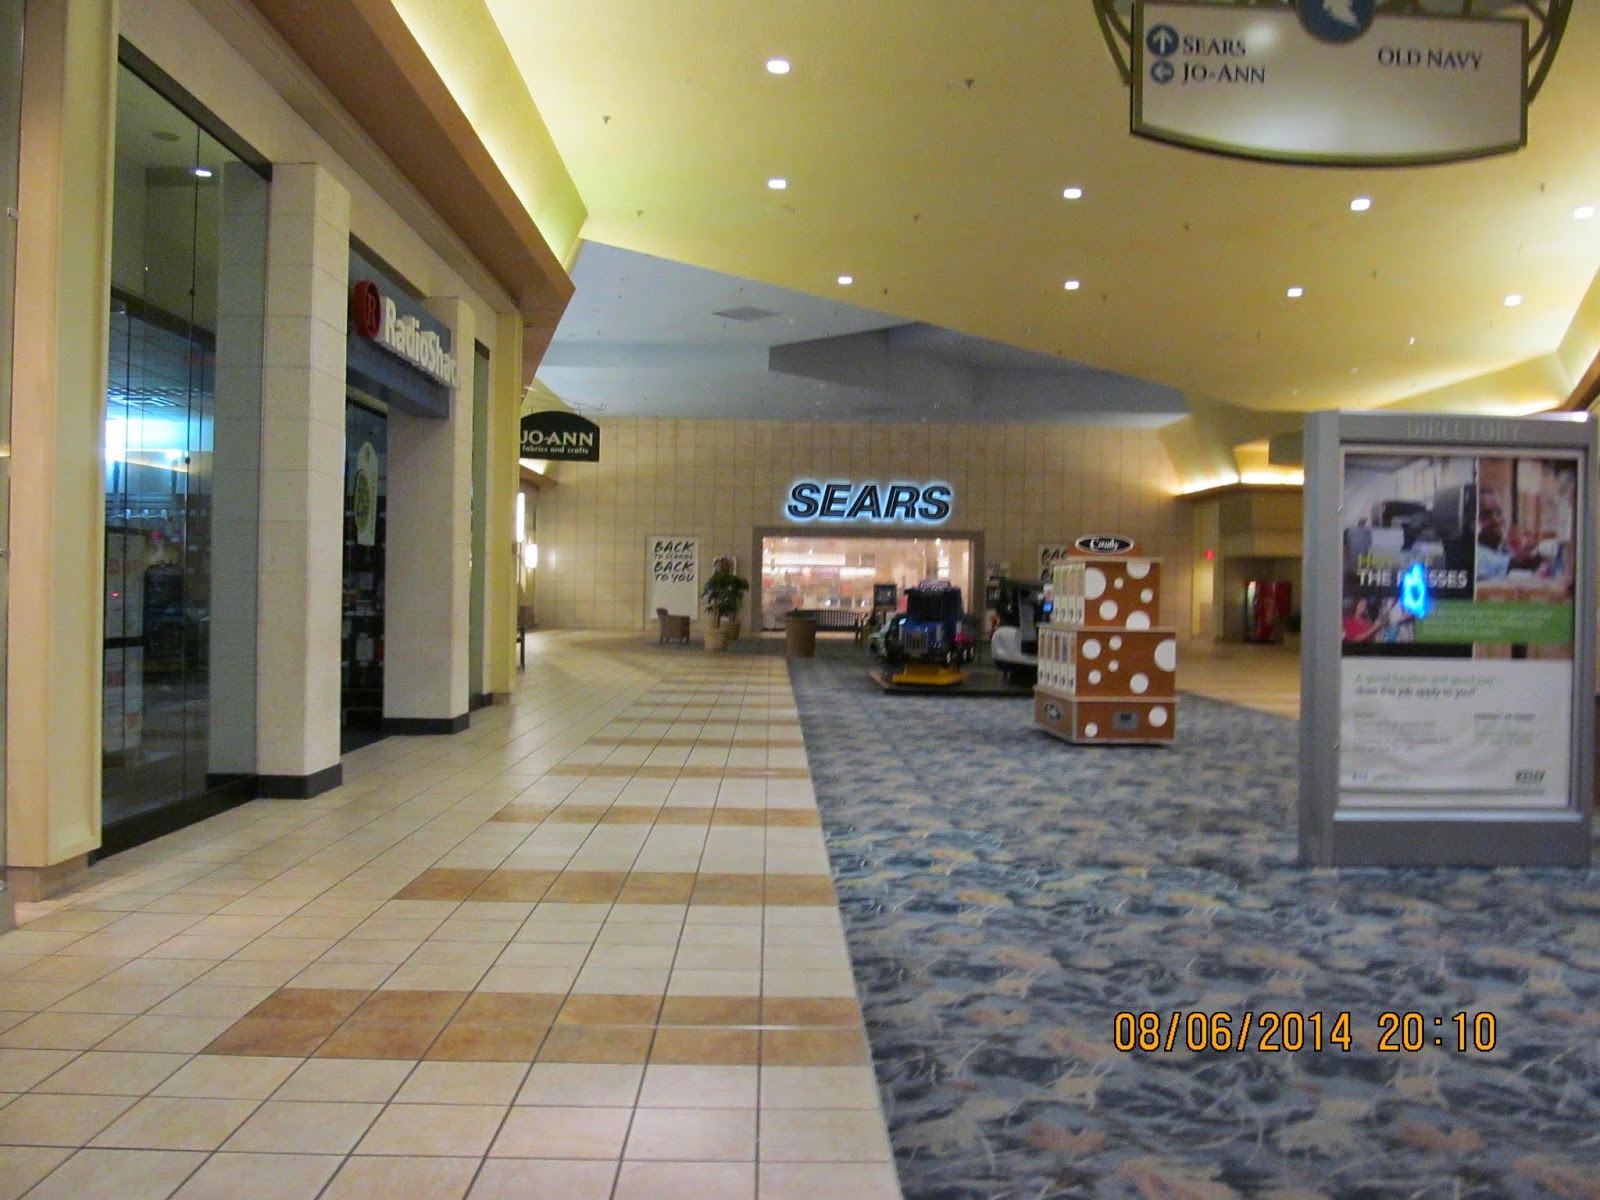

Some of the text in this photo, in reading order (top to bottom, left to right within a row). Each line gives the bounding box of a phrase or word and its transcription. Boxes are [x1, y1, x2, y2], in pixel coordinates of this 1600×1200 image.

[1182, 34, 1246, 57] SEARS
[1377, 45, 1482, 71] OLD NAVY
[1182, 62, 1266, 86] JO-ANN
[520, 429, 594, 447] JO-ANN
[522, 444, 589, 455] fabrics and crafts
[787, 483, 952, 520] SEARS
[654, 540, 695, 553] BACK
[1089, 536, 1120, 551] Candy
[653, 561, 695, 573] BACK
[655, 573, 695, 584] TO YOU
[1357, 567, 1393, 587] THE
